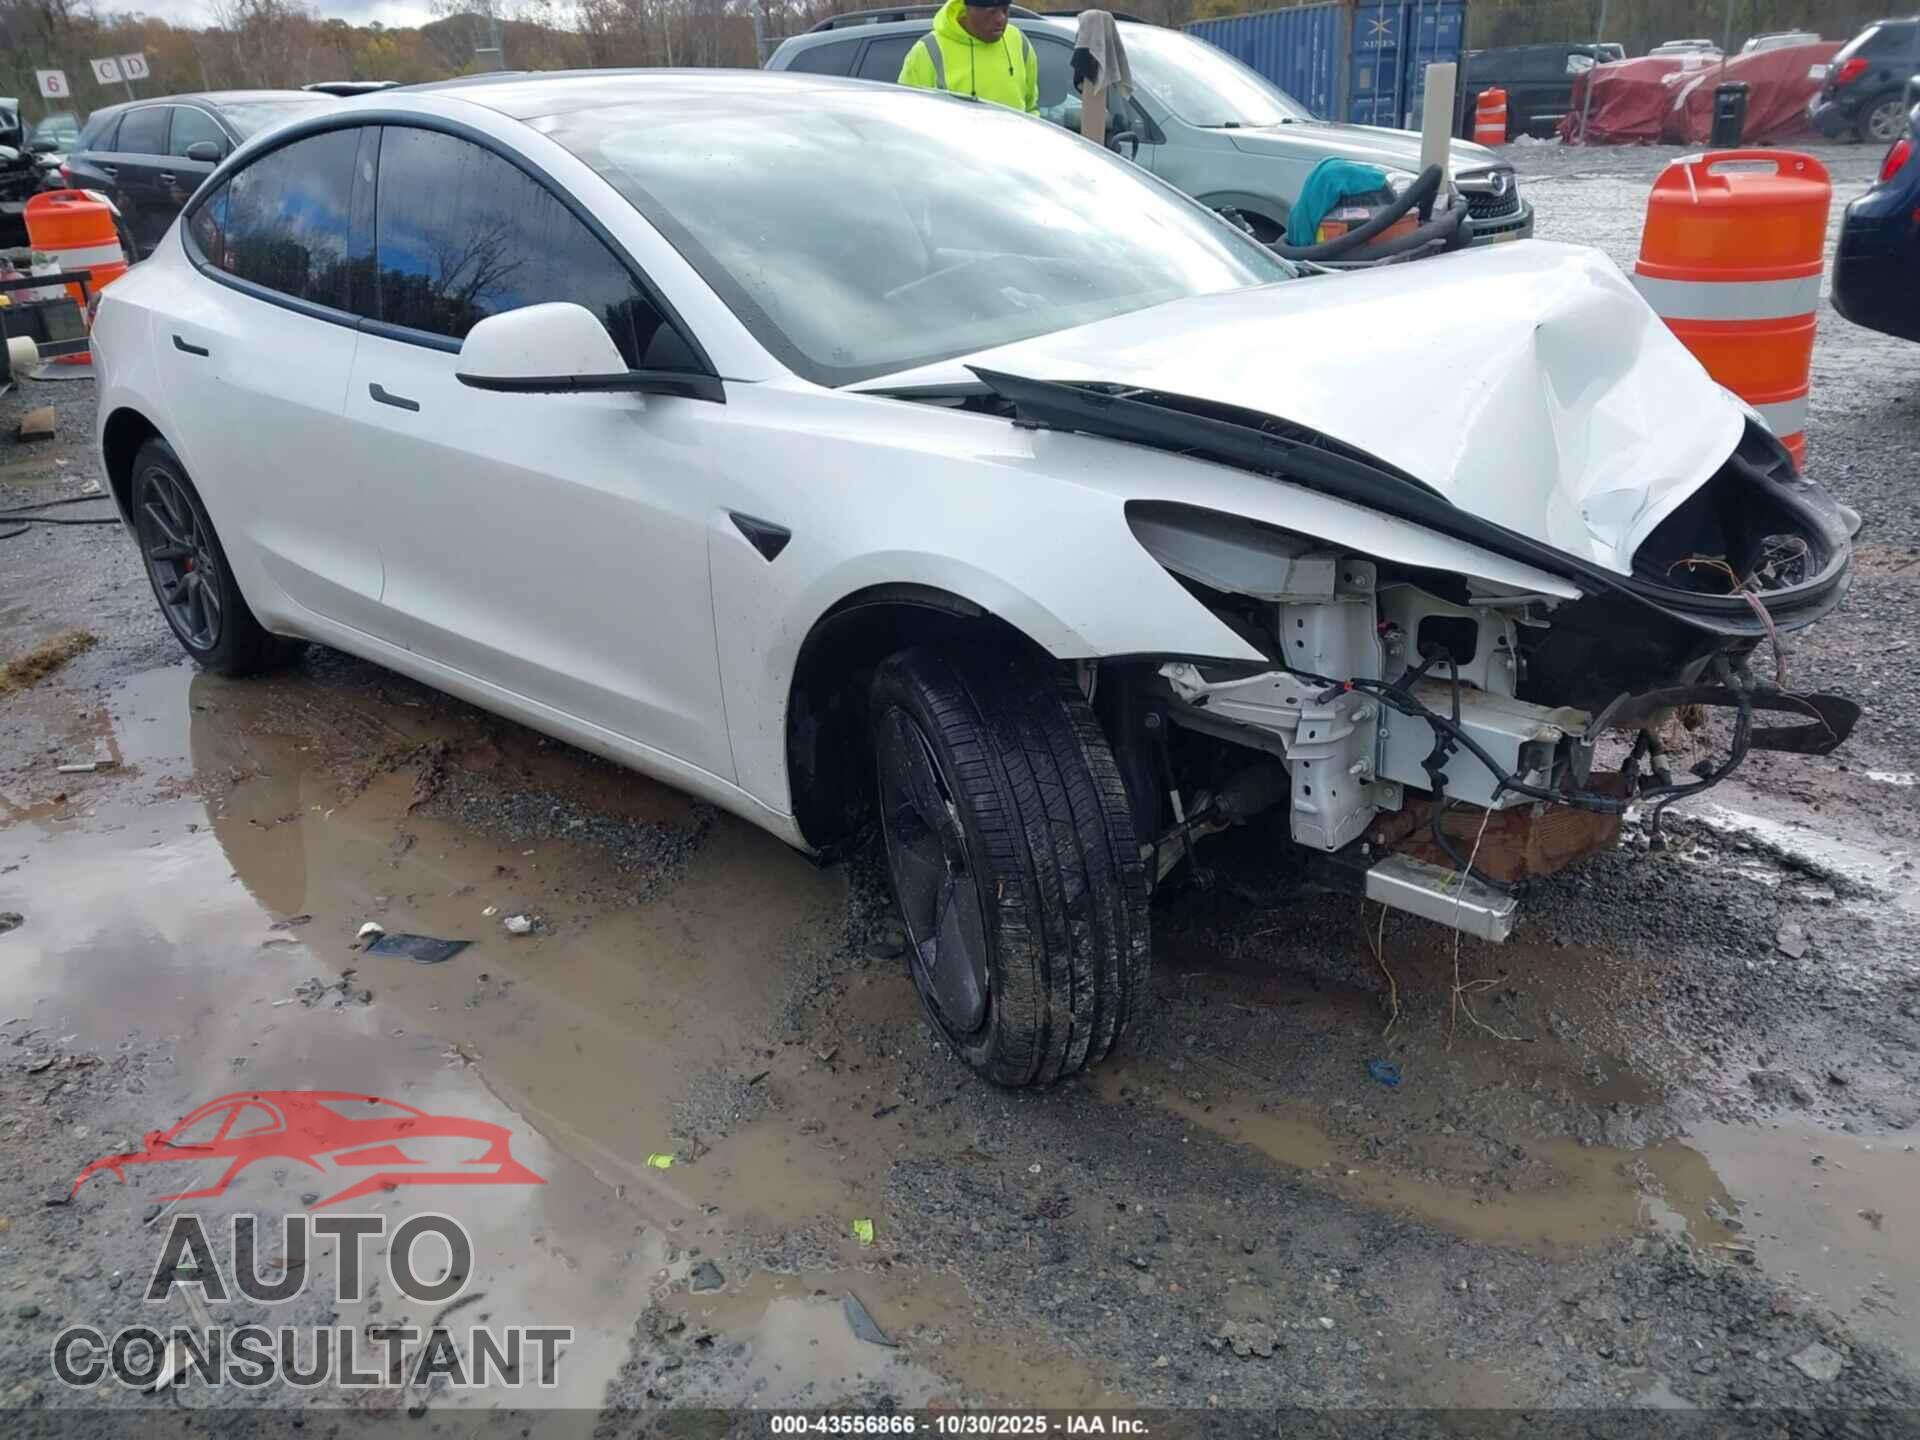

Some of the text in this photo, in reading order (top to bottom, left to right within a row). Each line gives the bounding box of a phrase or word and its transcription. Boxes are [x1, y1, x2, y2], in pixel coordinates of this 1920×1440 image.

[100, 58, 143, 79] C D
[47, 76, 60, 92] 6
